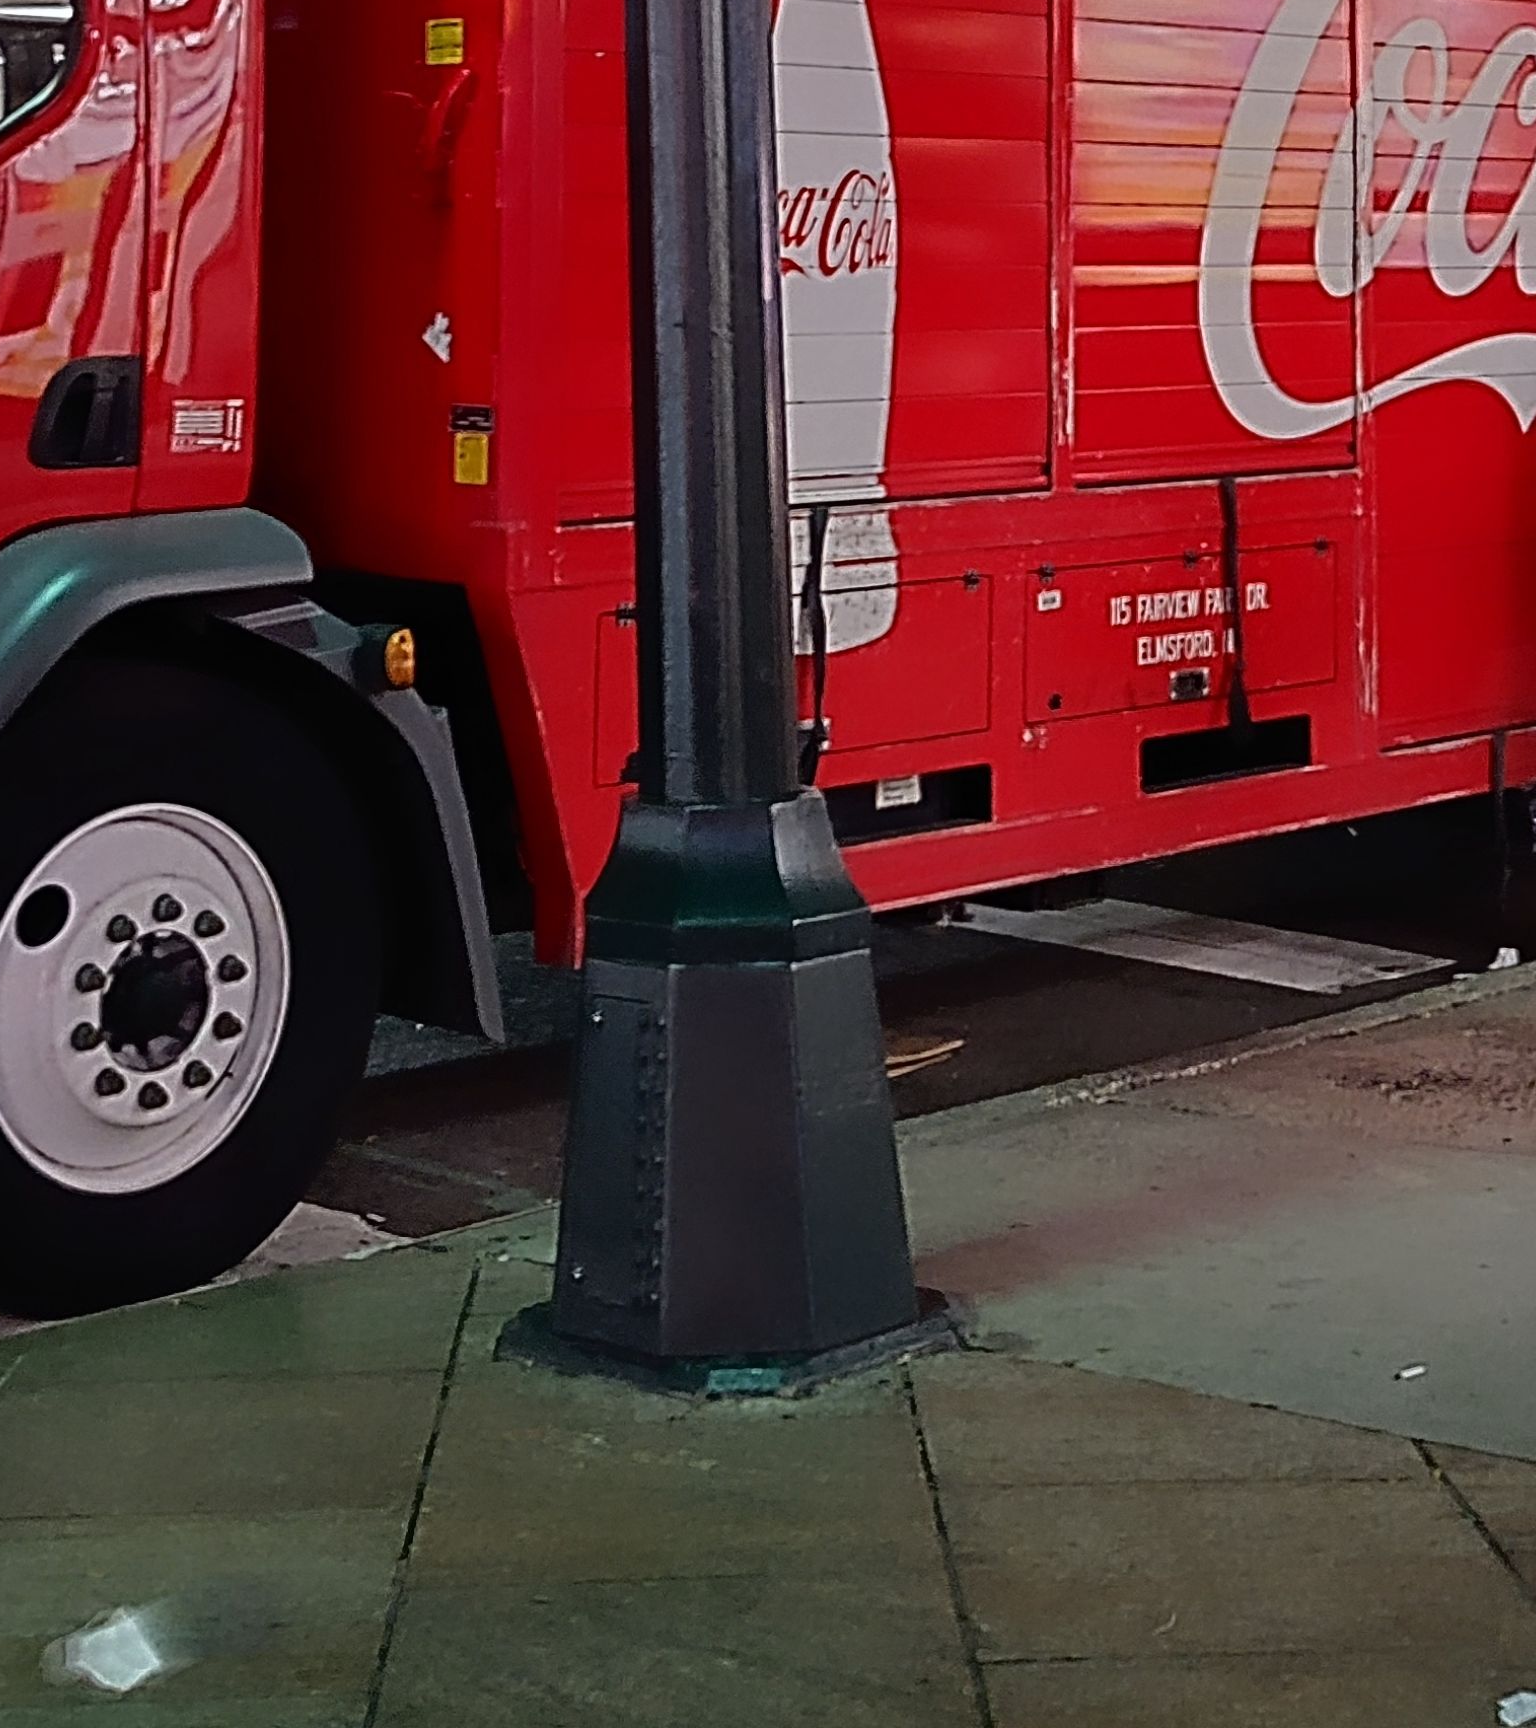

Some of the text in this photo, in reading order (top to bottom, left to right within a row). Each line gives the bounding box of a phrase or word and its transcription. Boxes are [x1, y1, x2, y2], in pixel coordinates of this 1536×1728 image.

[1110, 582, 1273, 626] 115 FAIRVIEW PAR DR.
